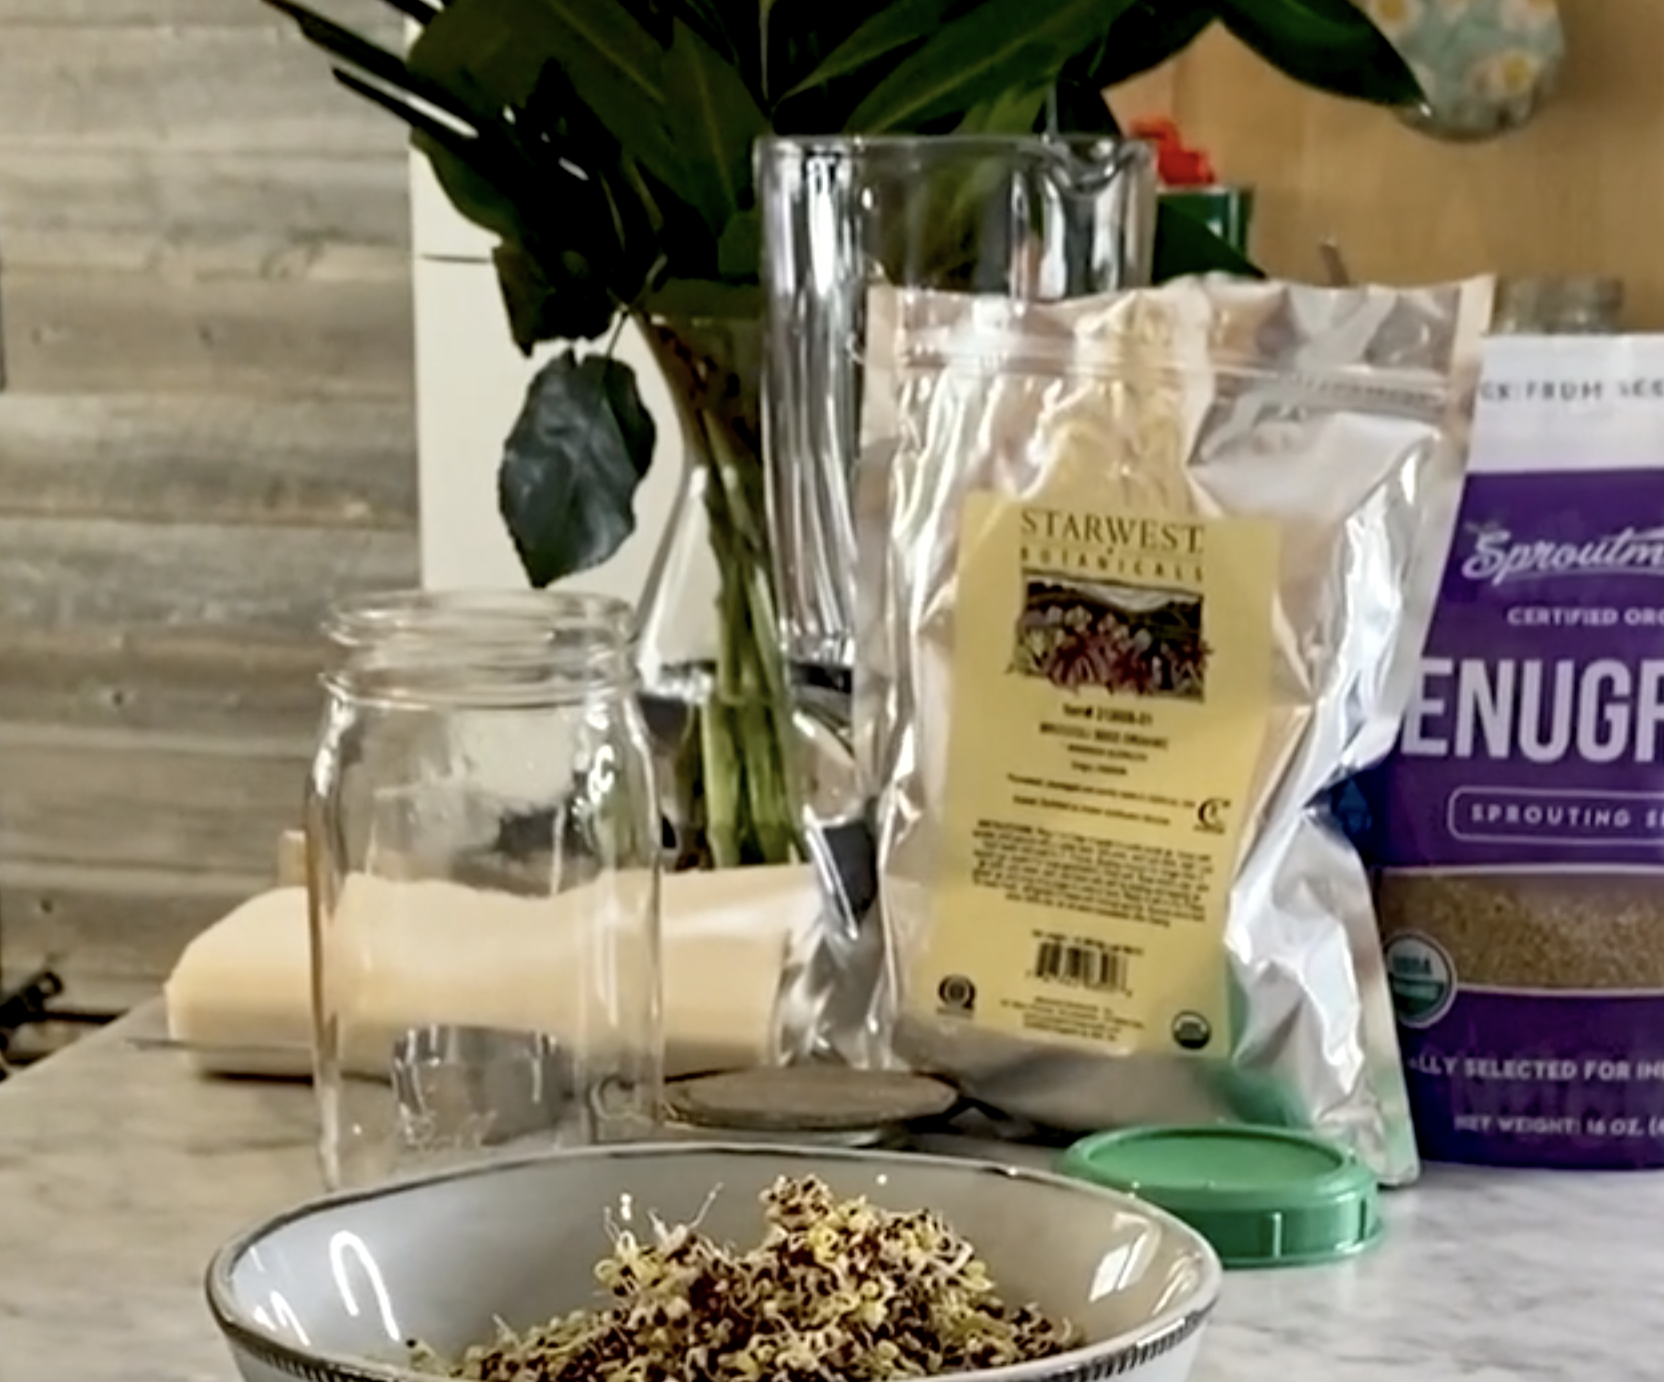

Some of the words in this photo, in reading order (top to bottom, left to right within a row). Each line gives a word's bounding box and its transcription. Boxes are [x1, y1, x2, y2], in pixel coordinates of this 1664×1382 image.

[1021, 509, 1205, 554] STARWEST
[1507, 605, 1619, 626] CERTIFIED
[1471, 802, 1632, 828] SPROUTING
[1463, 1056, 1578, 1080] SELECTED
[1585, 1059, 1631, 1081] FOR
